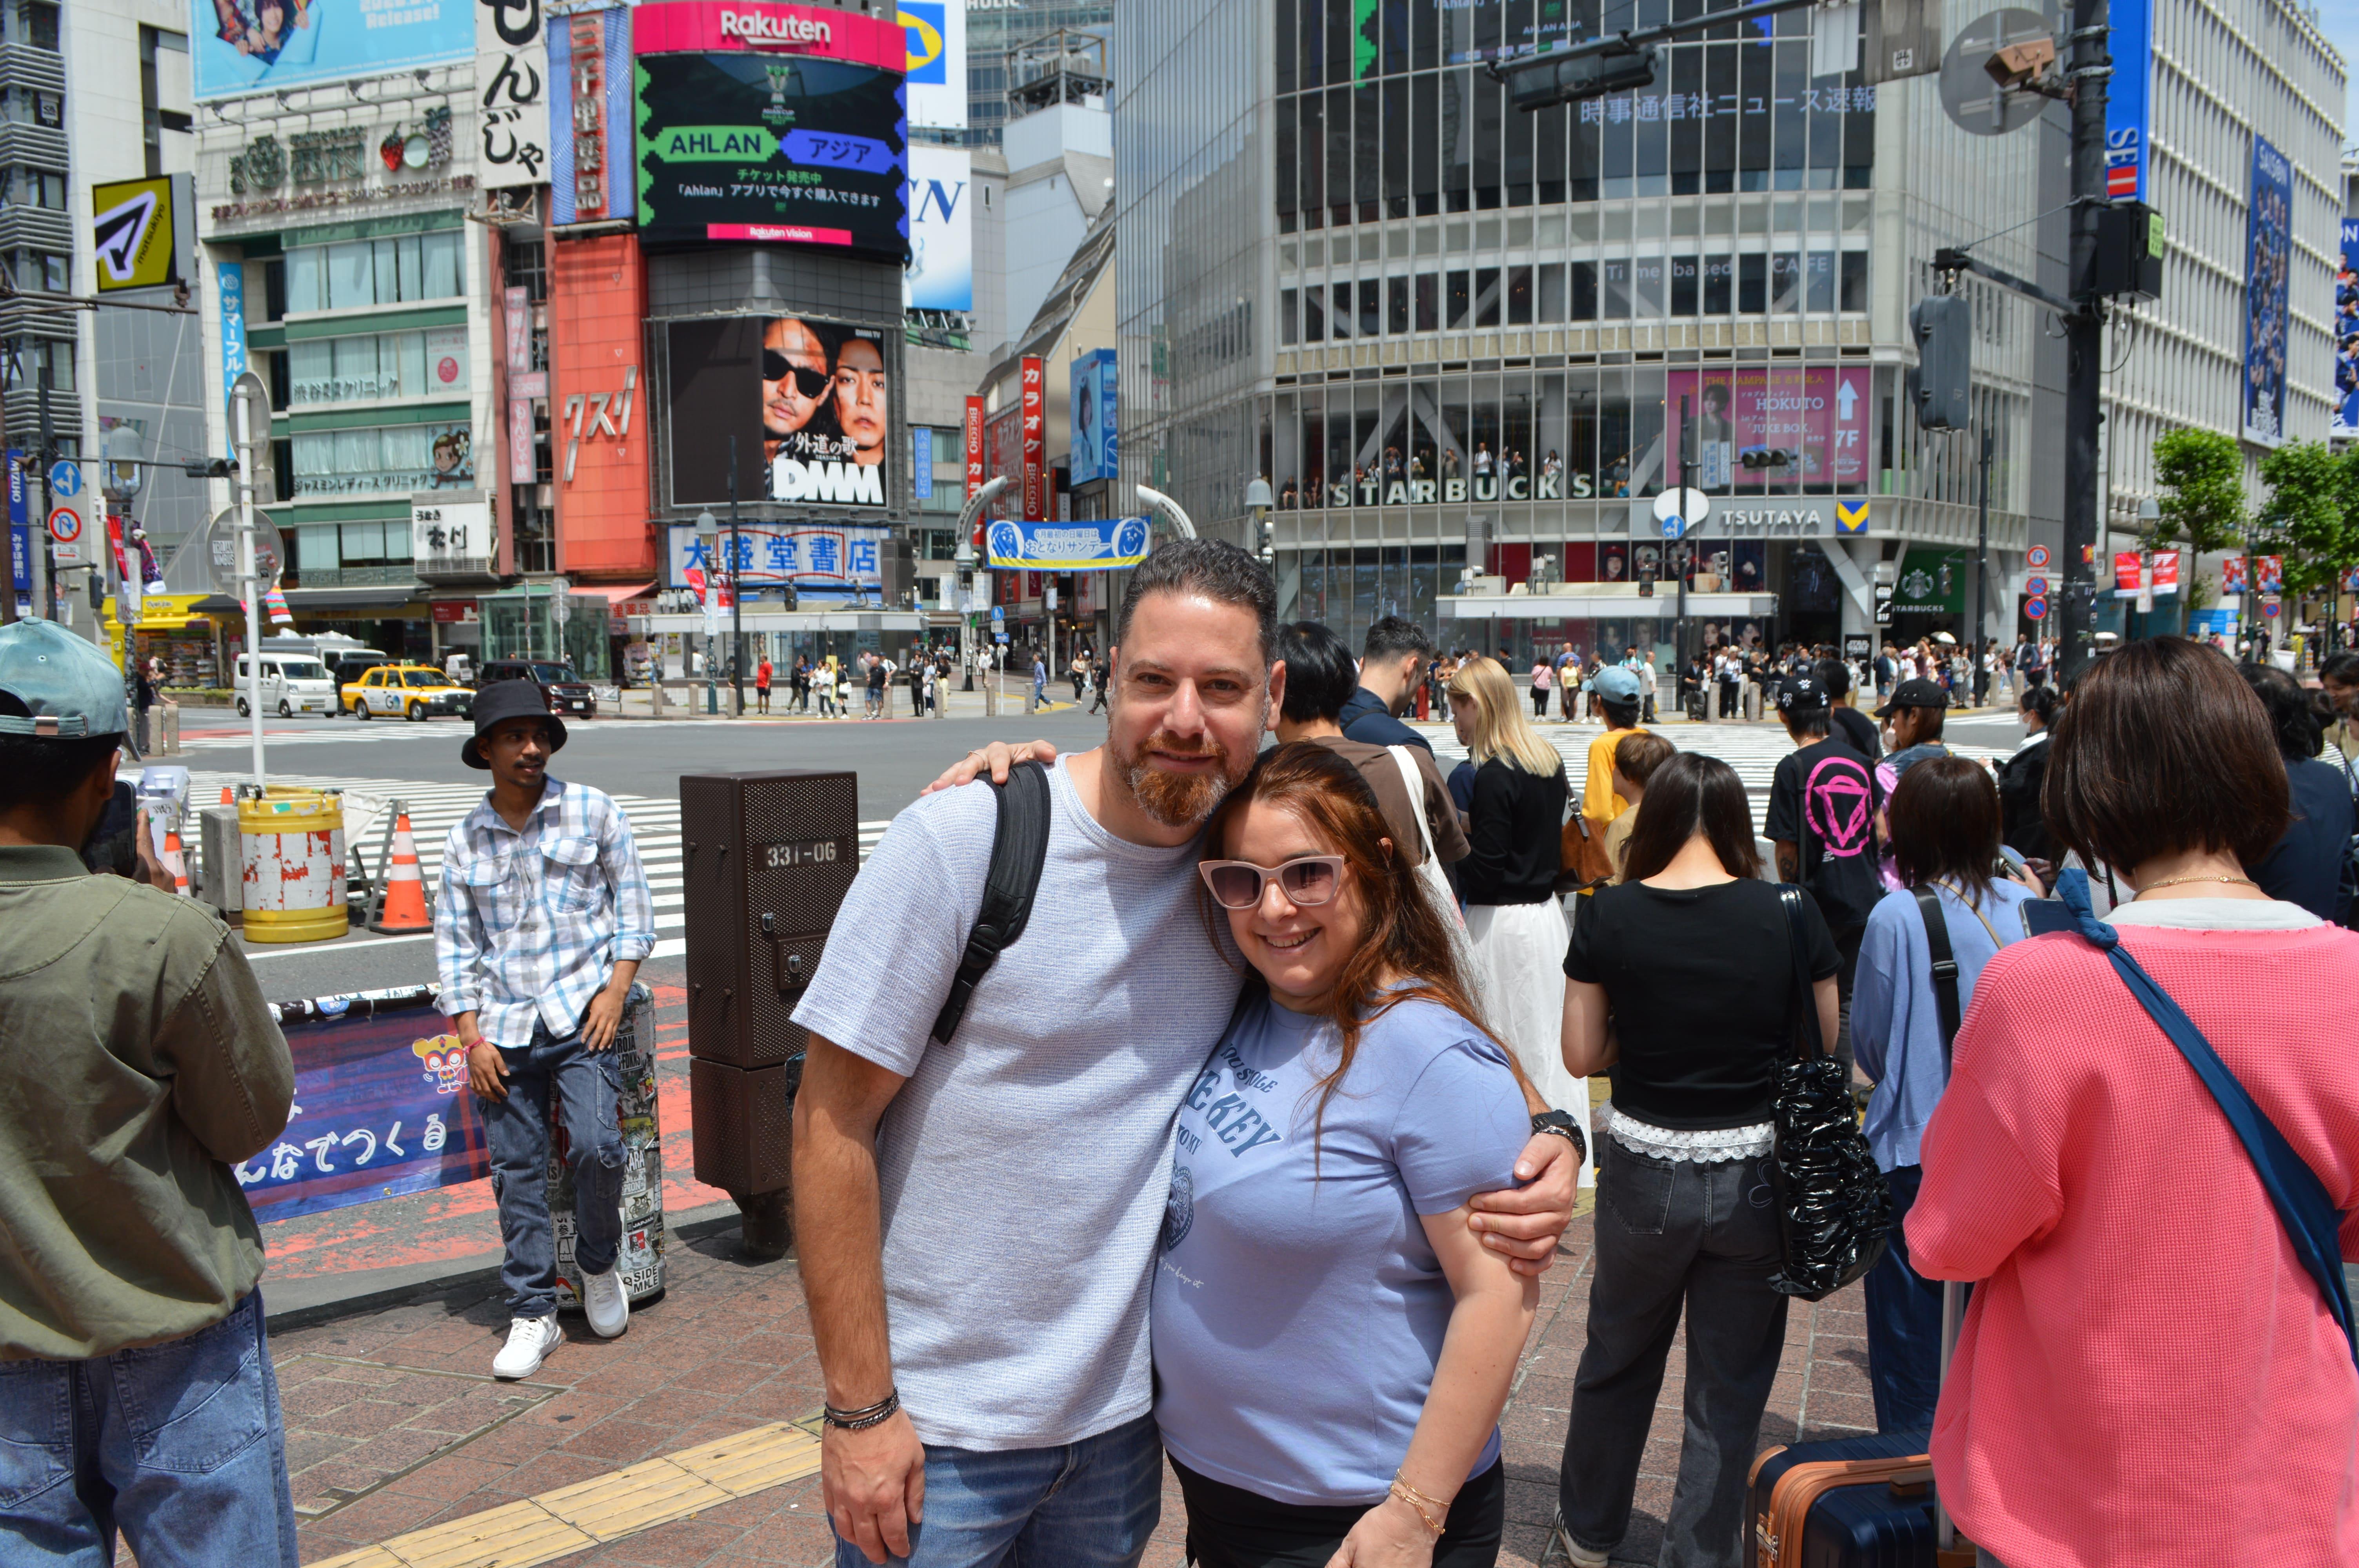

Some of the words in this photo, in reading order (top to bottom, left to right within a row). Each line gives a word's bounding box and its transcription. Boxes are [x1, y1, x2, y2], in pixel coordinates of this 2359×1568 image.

[721, 10, 831, 42] Rakuten
[1581, 86, 1877, 125] 時事通信社ニュース速報
[670, 134, 761, 154] AHLAN
[809, 138, 871, 163] アジア
[737, 169, 822, 184] チケット発売中
[2258, 145, 2287, 187] SAISON
[731, 184, 880, 207] アプリで今すぐ購入できます
[138, 204, 165, 265] matsukiyo
[750, 227, 785, 237] Rakuten
[787, 229, 812, 239] Vision
[1772, 256, 1828, 274] CAFE
[1705, 376, 1726, 385] THE
[1024, 368, 1040, 452] カラオケ
[1756, 396, 1824, 411] HOKUTO
[562, 365, 638, 482] クスリ
[968, 407, 978, 426] BIG
[795, 432, 860, 456] 外道の歌
[970, 426, 979, 454] ECHO
[1836, 430, 1860, 448] 7F
[10, 459, 21, 503] MIZUHO
[773, 458, 884, 504] DMM
[1025, 463, 1037, 483] BIG
[1028, 485, 1038, 516] ECHO
[1334, 474, 1592, 507] STARBUCKS
[1723, 509, 1821, 526] TSUTAYA
[1034, 529, 1098, 539] 6月最初の日曜日は
[683, 536, 876, 573] 大盛堂書店
[1026, 541, 1111, 554] おとなりサンデー
[1877, 613, 1890, 622] B1F
[767, 841, 836, 867] 331-06
[1205, 1092, 1282, 1159] KEY
[1187, 1134, 1203, 1156] MY
[633, 1216, 654, 1228] JAPJAN
[633, 1265, 658, 1283] SIDE
